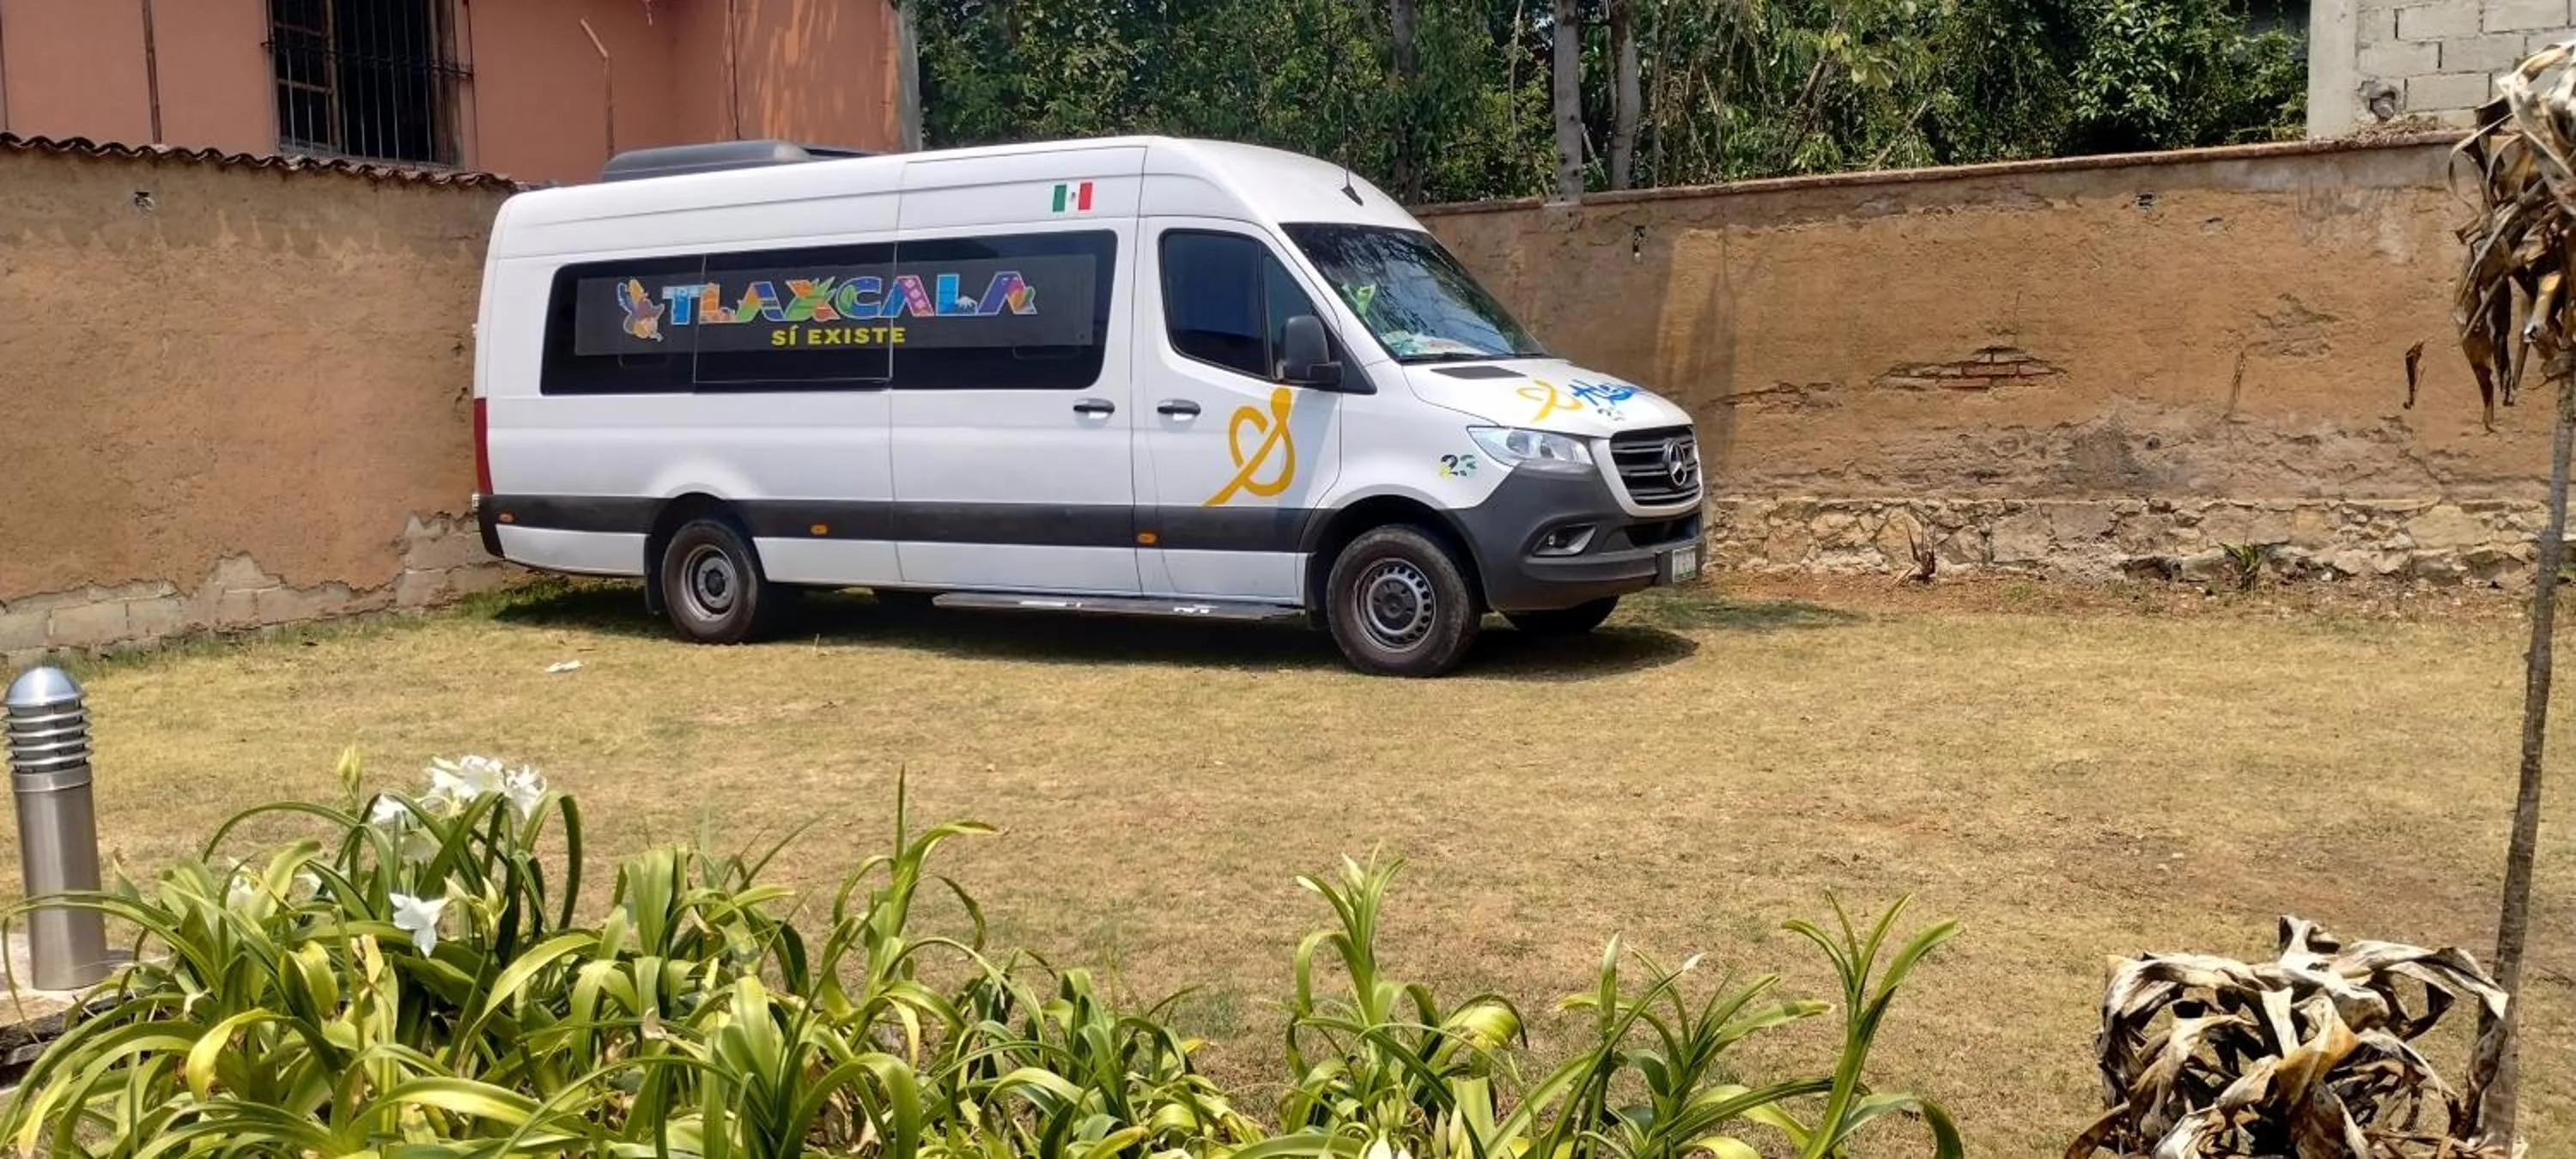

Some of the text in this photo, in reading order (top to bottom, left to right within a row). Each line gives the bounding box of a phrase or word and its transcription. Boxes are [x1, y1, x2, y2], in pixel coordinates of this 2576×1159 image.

[662, 271, 1037, 325] TLAXCALA
[771, 325, 906, 346] SÍ EXISTE
